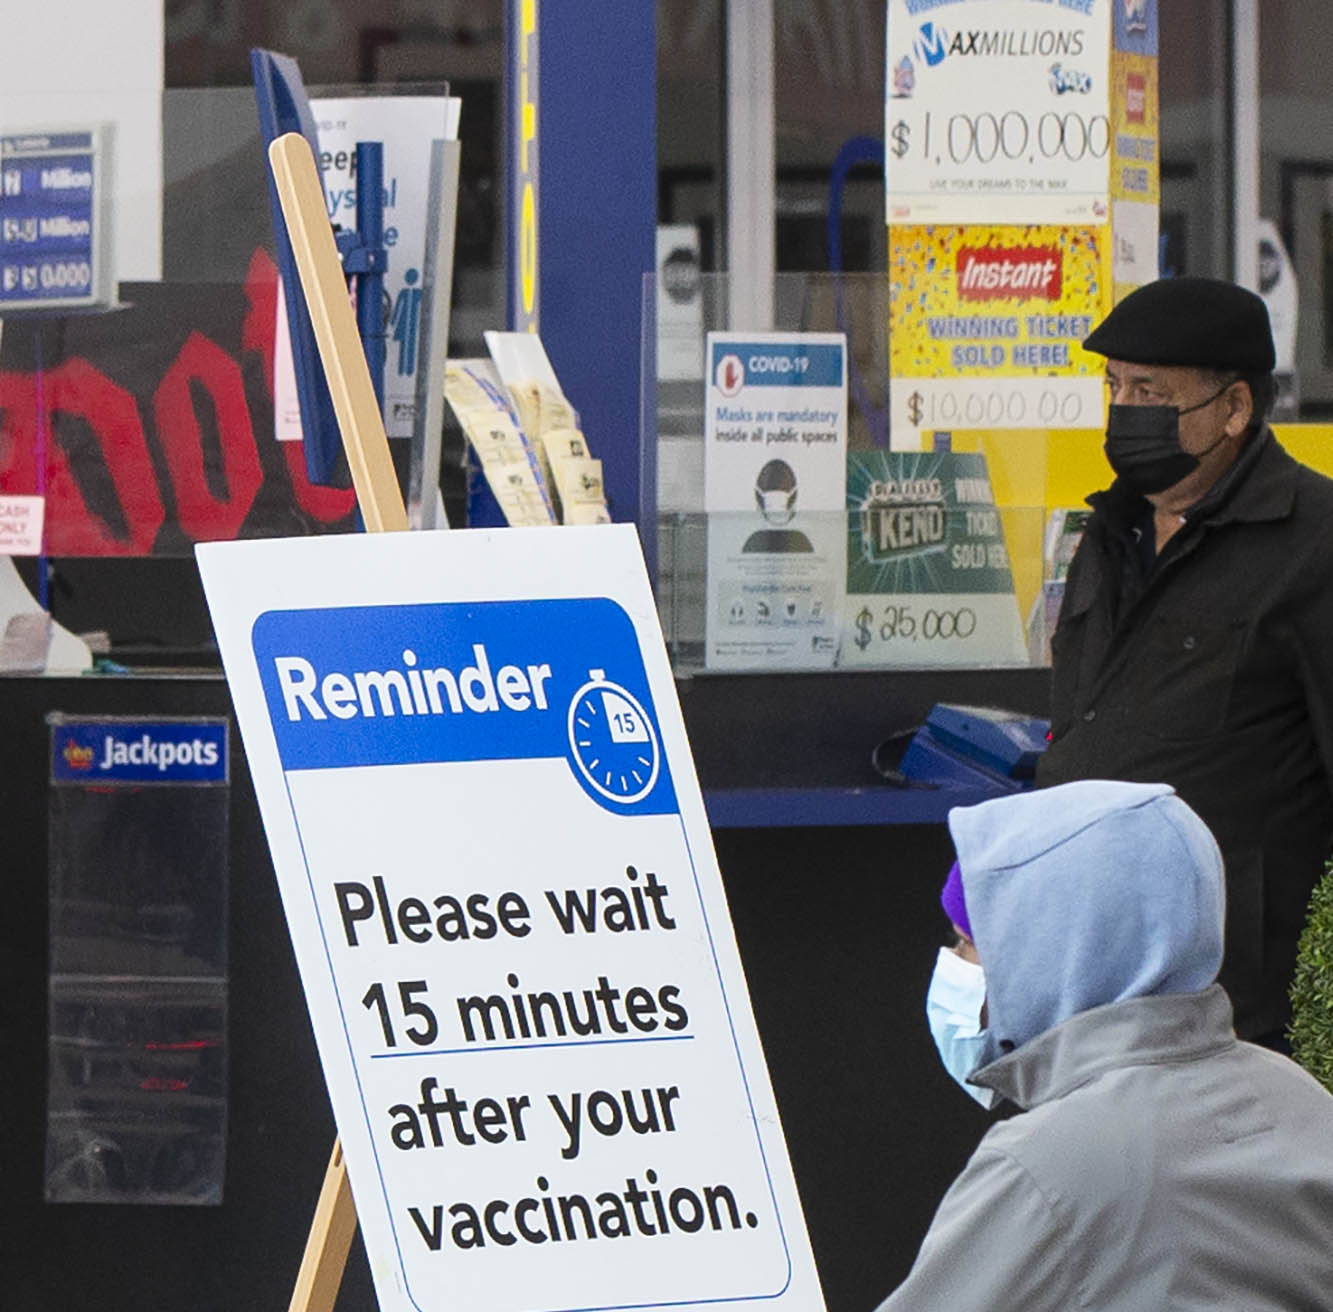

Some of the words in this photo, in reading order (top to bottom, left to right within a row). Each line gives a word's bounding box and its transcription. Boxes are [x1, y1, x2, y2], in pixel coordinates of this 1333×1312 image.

[961, 257, 1057, 289] Instant
[927, 317, 1018, 338] WINNING
[1027, 316, 1093, 338] TICKET
[749, 356, 809, 373] COVID-19
[952, 345, 1005, 366] SOLD
[1012, 345, 1069, 366] HERE!
[715, 406, 752, 421] Masks
[755, 411, 774, 421] are
[777, 408, 839, 427] mandatory
[715, 427, 748, 441] inside
[750, 426, 763, 441] all
[766, 426, 798, 445] public
[801, 432, 839, 447] spaces
[879, 504, 945, 550] KENO
[274, 645, 552, 721] Reminder
[614, 709, 637, 737] 15
[100, 734, 220, 771] Jackpots
[333, 876, 532, 947] Please
[545, 866, 677, 935] wait
[361, 979, 439, 1048] 15
[456, 974, 689, 1043] minutes
[387, 1077, 531, 1151] after
[546, 1086, 680, 1160] your
[407, 1168, 759, 1252] vaccination.
